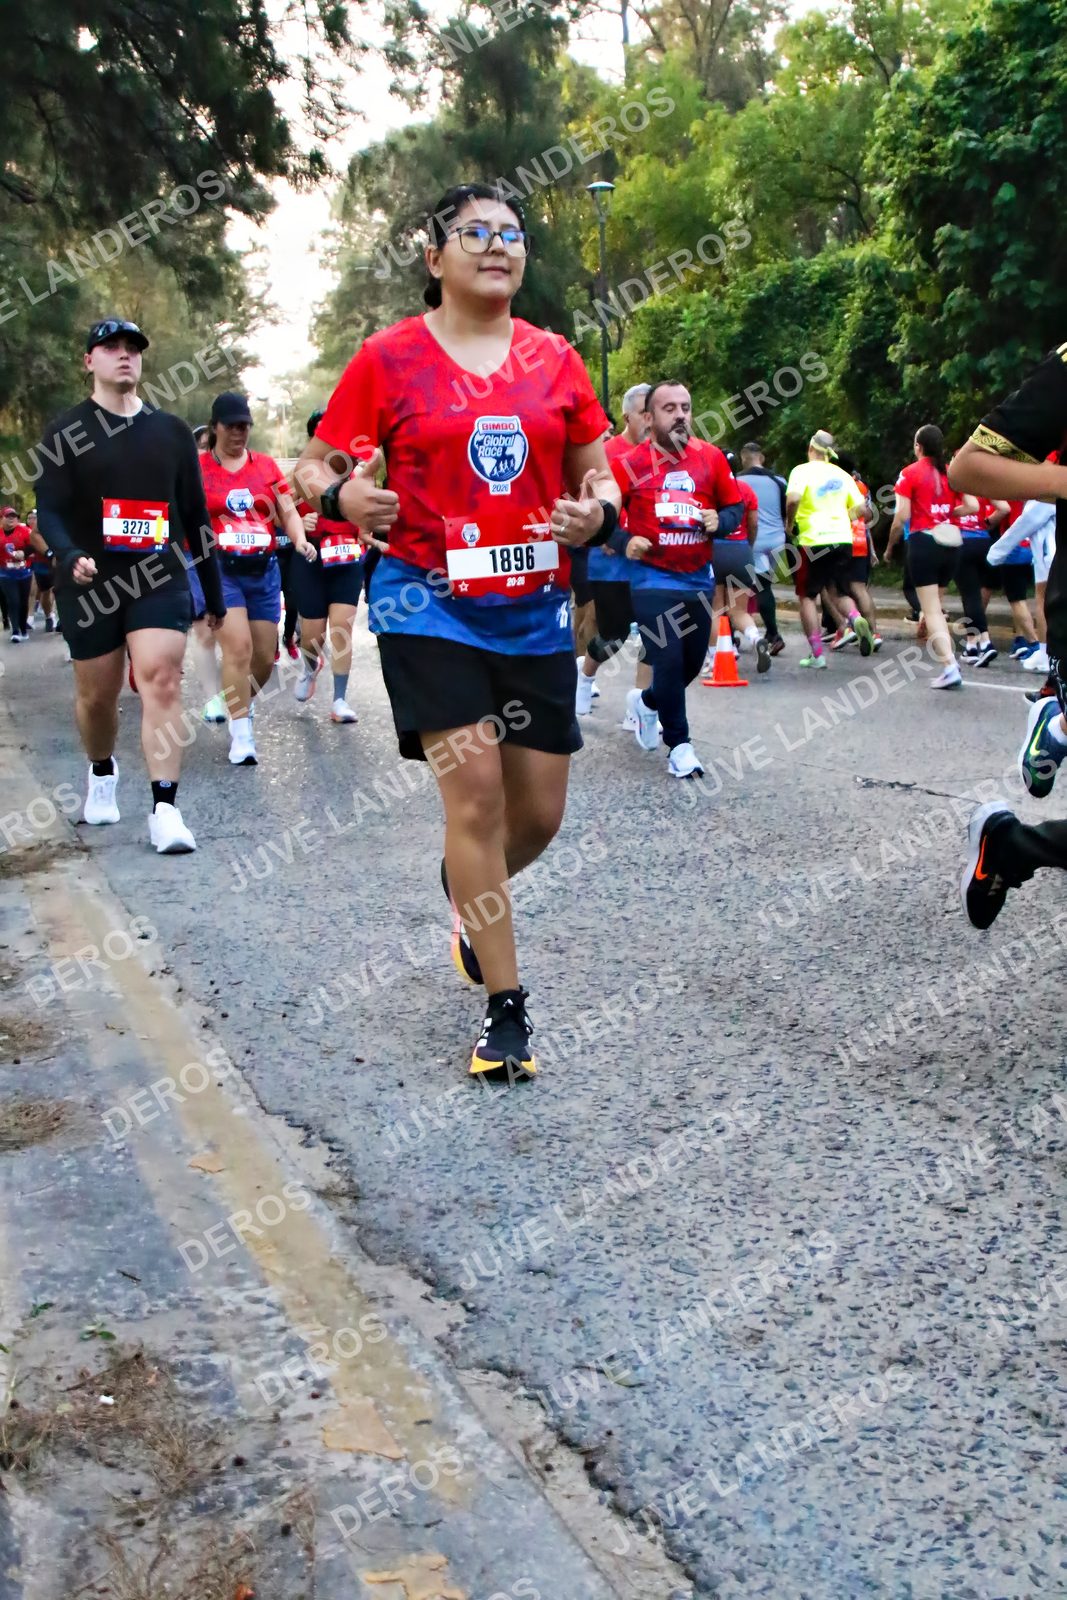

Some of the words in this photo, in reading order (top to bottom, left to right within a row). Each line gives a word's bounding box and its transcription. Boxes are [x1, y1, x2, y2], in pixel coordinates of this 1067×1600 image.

[483, 434, 515, 446] Global
[478, 446, 503, 457] Race
[674, 504, 694, 516] 3119
[122, 520, 150, 535] 3273
[235, 534, 255, 544] 3613
[659, 533, 708, 545] SANTIA
[334, 545, 351, 554] 2142
[489, 545, 535, 573] 1896
